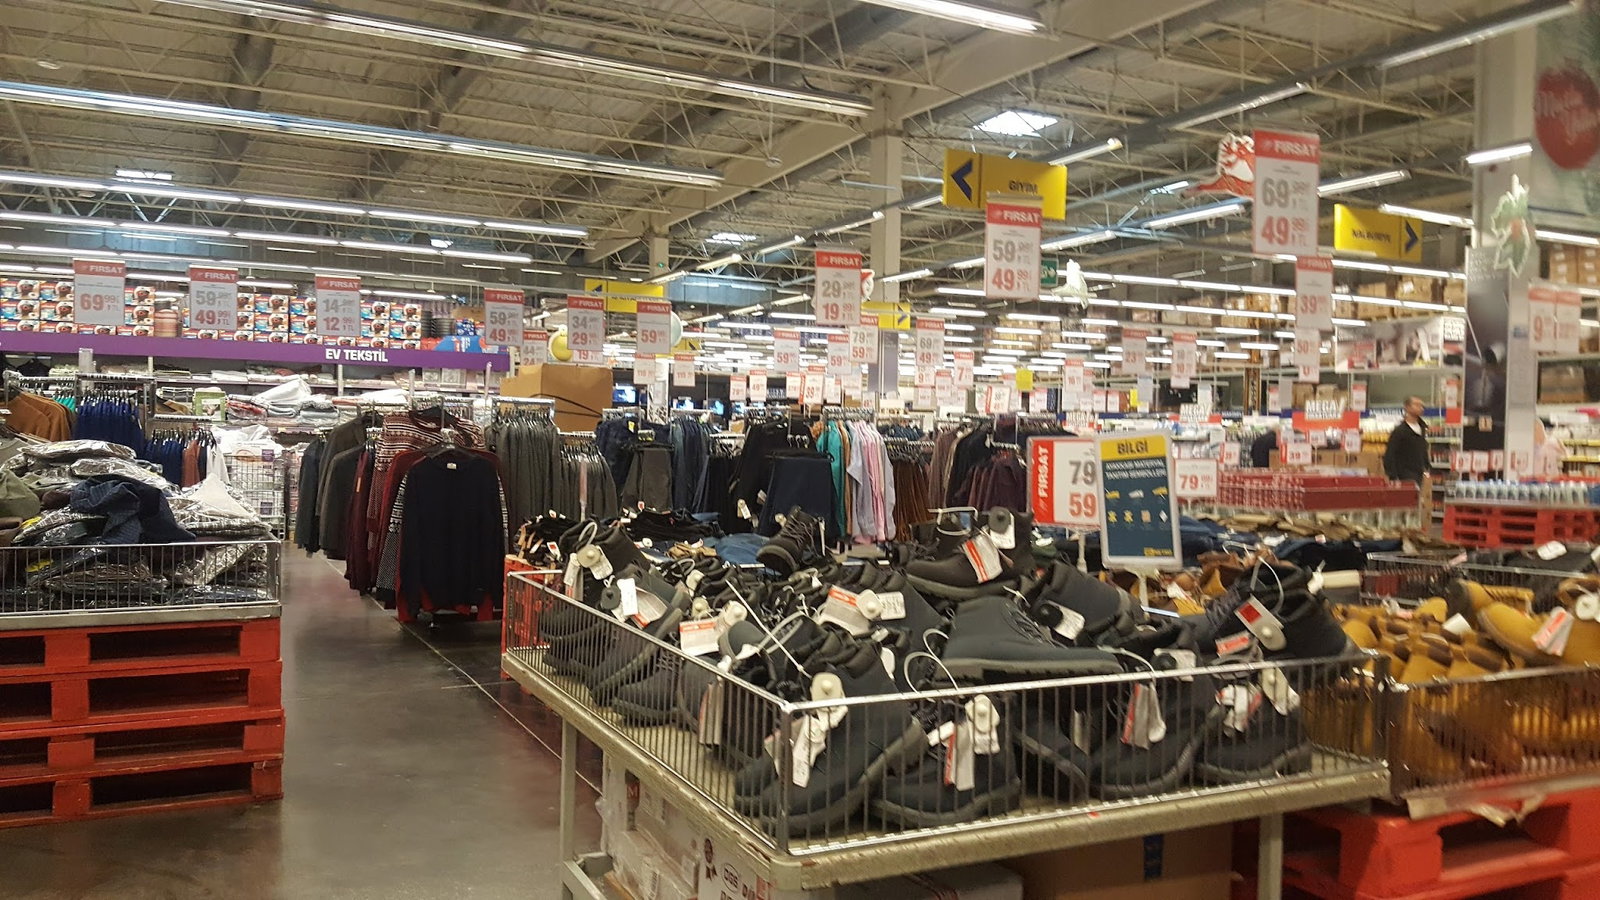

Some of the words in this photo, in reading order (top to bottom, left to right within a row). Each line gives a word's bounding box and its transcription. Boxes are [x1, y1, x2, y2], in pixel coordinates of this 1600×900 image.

[1274, 139, 1316, 157] FIRSAT
[1262, 177, 1289, 208] 69
[1003, 210, 1040, 223] FIRSAT
[1262, 216, 1289, 246] 49
[992, 239, 1016, 262] 59
[829, 256, 860, 266] FIRSAT
[89, 265, 123, 274] FIRSAT
[204, 272, 236, 280] FIRSAT
[992, 268, 1015, 291] 49
[822, 280, 840, 297] 29
[80, 293, 104, 311] 69
[196, 290, 216, 306] 59
[496, 294, 522, 302] FIRSAT
[578, 300, 602, 308] FIRSAT
[1300, 294, 1316, 314] 39
[323, 299, 338, 313] 14
[647, 304, 670, 313] FIRSAT
[822, 303, 839, 320] 19
[195, 310, 216, 325] 49
[323, 317, 340, 331] 12
[490, 312, 506, 326] 59
[572, 316, 588, 329] 34
[490, 328, 506, 342] 49
[572, 332, 588, 345] 29
[641, 330, 657, 343] 59
[325, 348, 342, 360] EV
[344, 348, 389, 362] TEKSTİL
[776, 352, 789, 364] 59
[852, 346, 865, 360] 59
[919, 352, 932, 364] 49
[1117, 438, 1148, 455] BİLGİ
[1038, 445, 1049, 498] FIRSAT
[1069, 460, 1097, 486] 79
[1180, 474, 1198, 491] 79
[1069, 492, 1097, 518] 59
